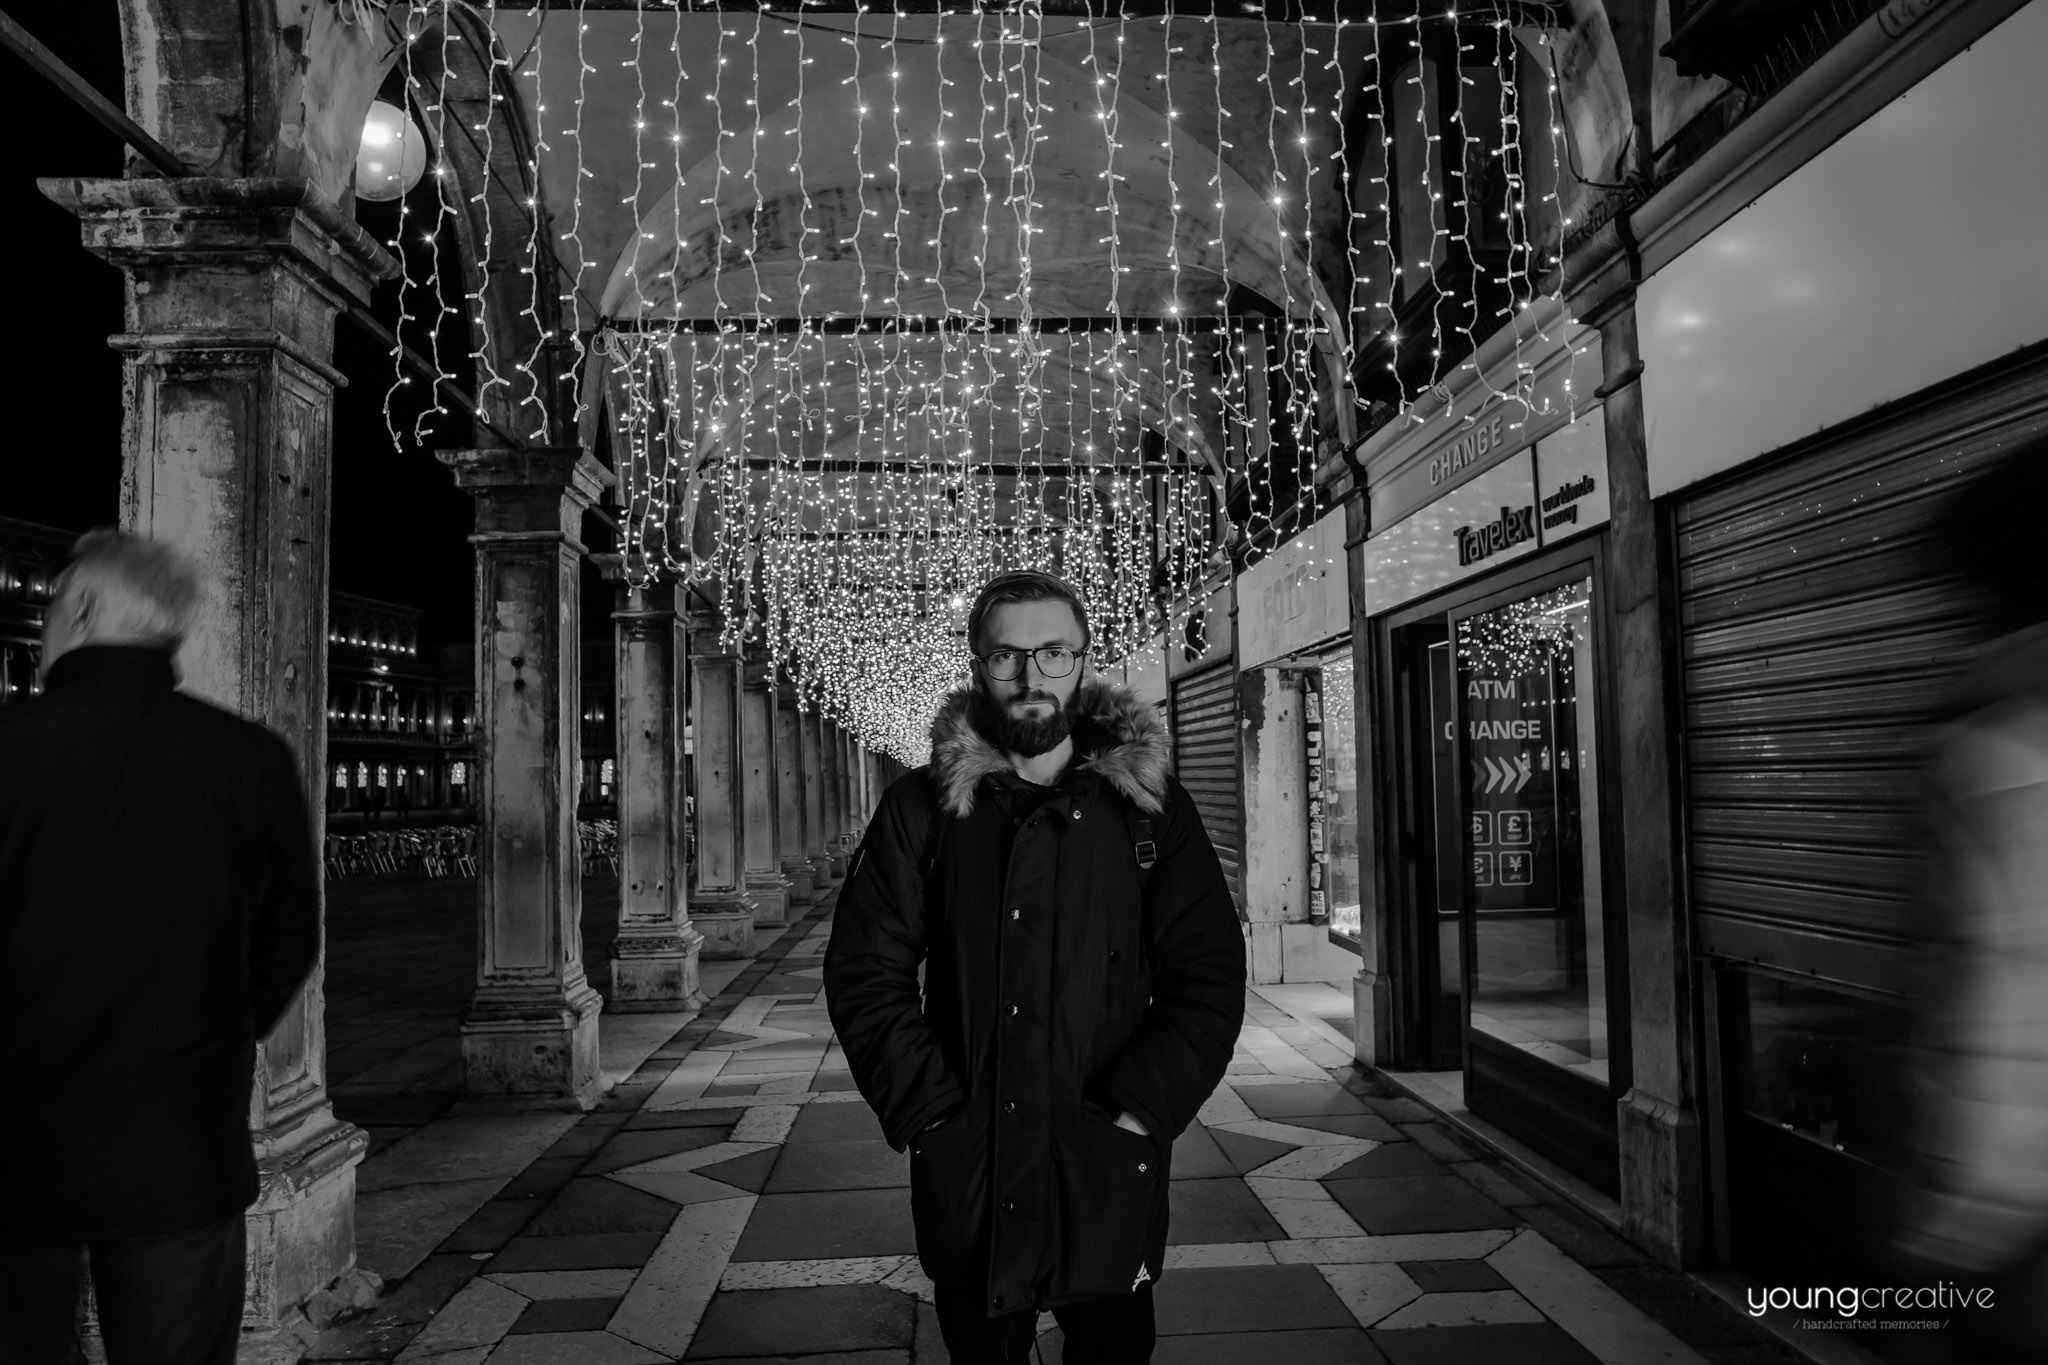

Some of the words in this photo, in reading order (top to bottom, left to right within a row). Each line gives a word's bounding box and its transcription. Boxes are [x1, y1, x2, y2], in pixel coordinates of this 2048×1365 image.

[1430, 416, 1504, 486] CHANGE
[1542, 475, 1595, 512] worldwide
[1543, 504, 1577, 530] money
[1453, 506, 1535, 566] Travelex
[1467, 680, 1516, 699] ATM
